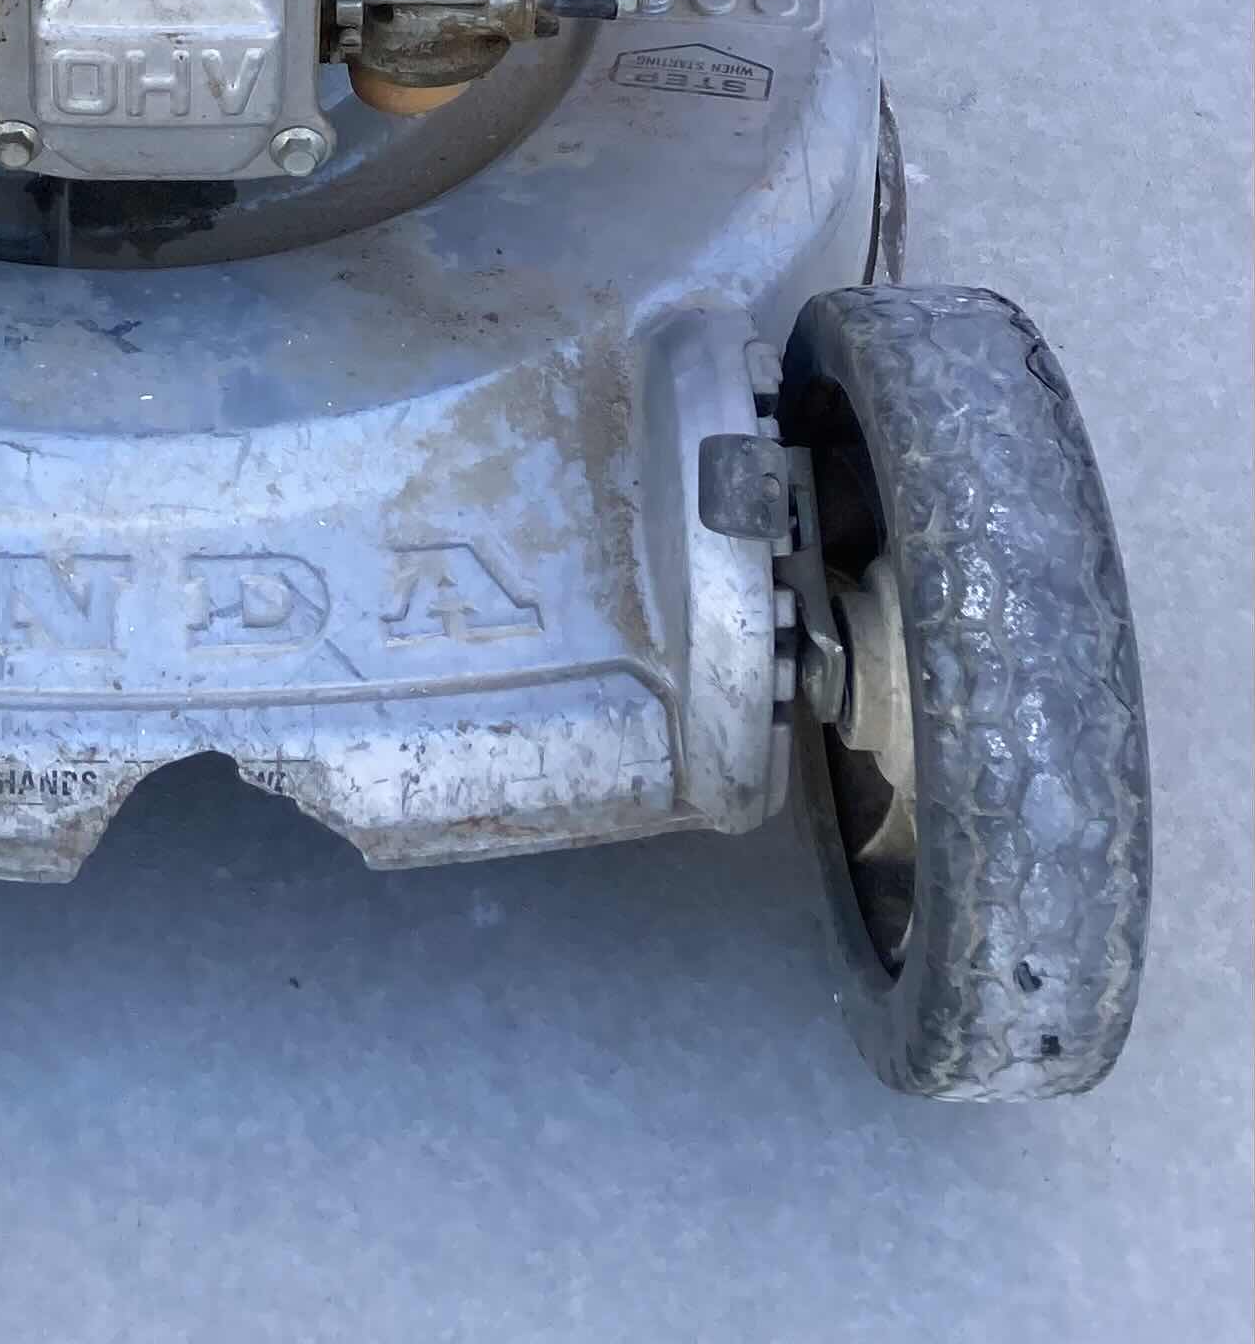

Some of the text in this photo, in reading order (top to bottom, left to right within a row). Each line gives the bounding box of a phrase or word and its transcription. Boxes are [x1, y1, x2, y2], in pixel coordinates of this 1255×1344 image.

[636, 54, 754, 77] WHEN STARTING
[50, 47, 266, 116] OHV
[635, 73, 747, 93] STEP
